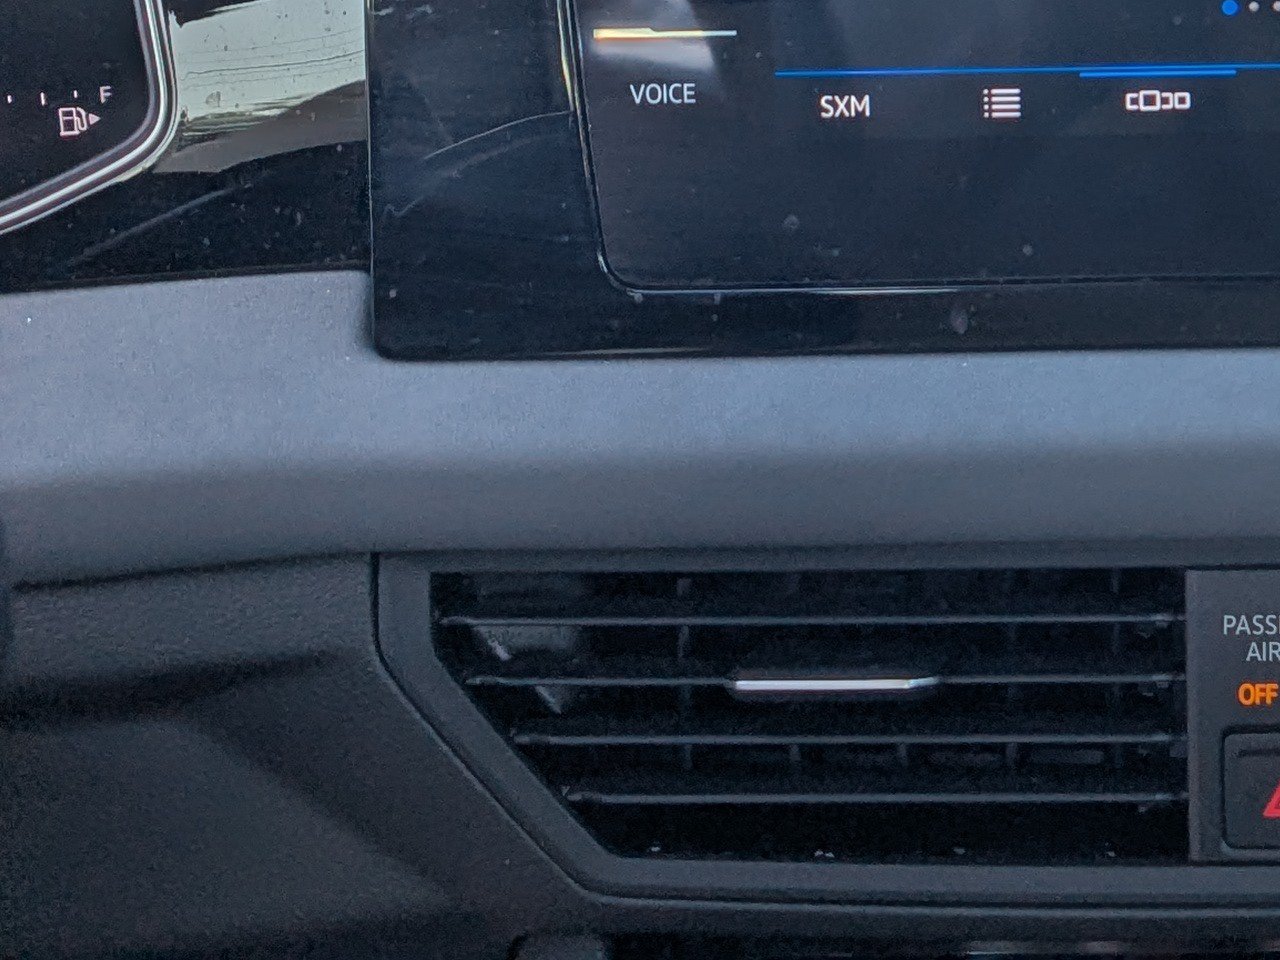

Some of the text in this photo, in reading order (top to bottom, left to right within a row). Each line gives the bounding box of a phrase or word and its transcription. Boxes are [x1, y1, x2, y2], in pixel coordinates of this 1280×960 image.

[100, 86, 113, 104] F
[629, 82, 697, 105] VOICE
[820, 94, 870, 120] SXM
[1237, 683, 1279, 706] OFF
